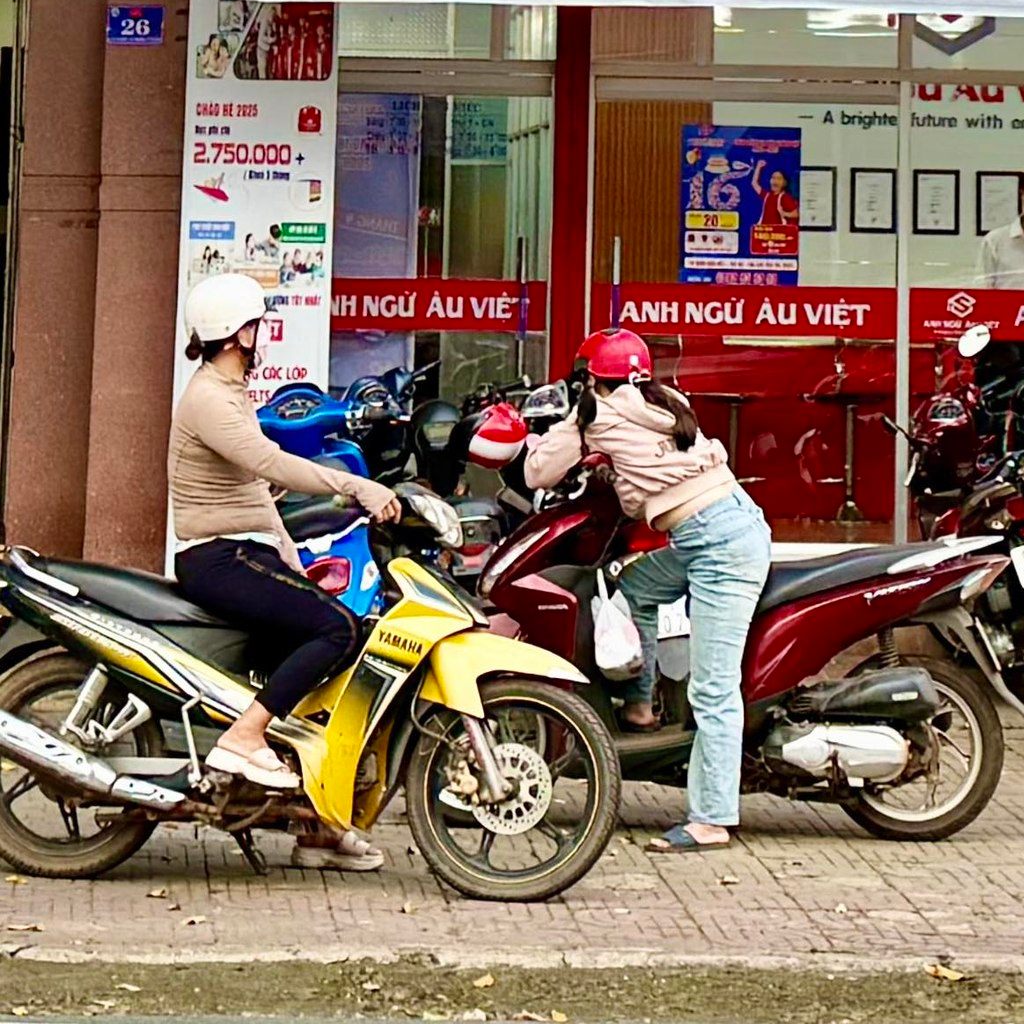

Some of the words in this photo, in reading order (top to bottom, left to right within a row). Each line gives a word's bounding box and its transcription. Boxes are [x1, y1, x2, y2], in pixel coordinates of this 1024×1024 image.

[120, 18, 151, 36] 26
[823, 110, 835, 124] A
[841, 110, 898, 130] brighte
[911, 112, 957, 129] future
[965, 114, 1003, 129] with
[193, 142, 292, 165] 2.750.000
[363, 291, 417, 318] NGỮ
[426, 291, 464, 319] ÂU
[618, 301, 679, 323] ANH
[684, 297, 745, 324] NGỮ
[755, 297, 797, 326] ÂU
[804, 298, 871, 328] VIỆT
[378, 629, 423, 655] YAMAHA
